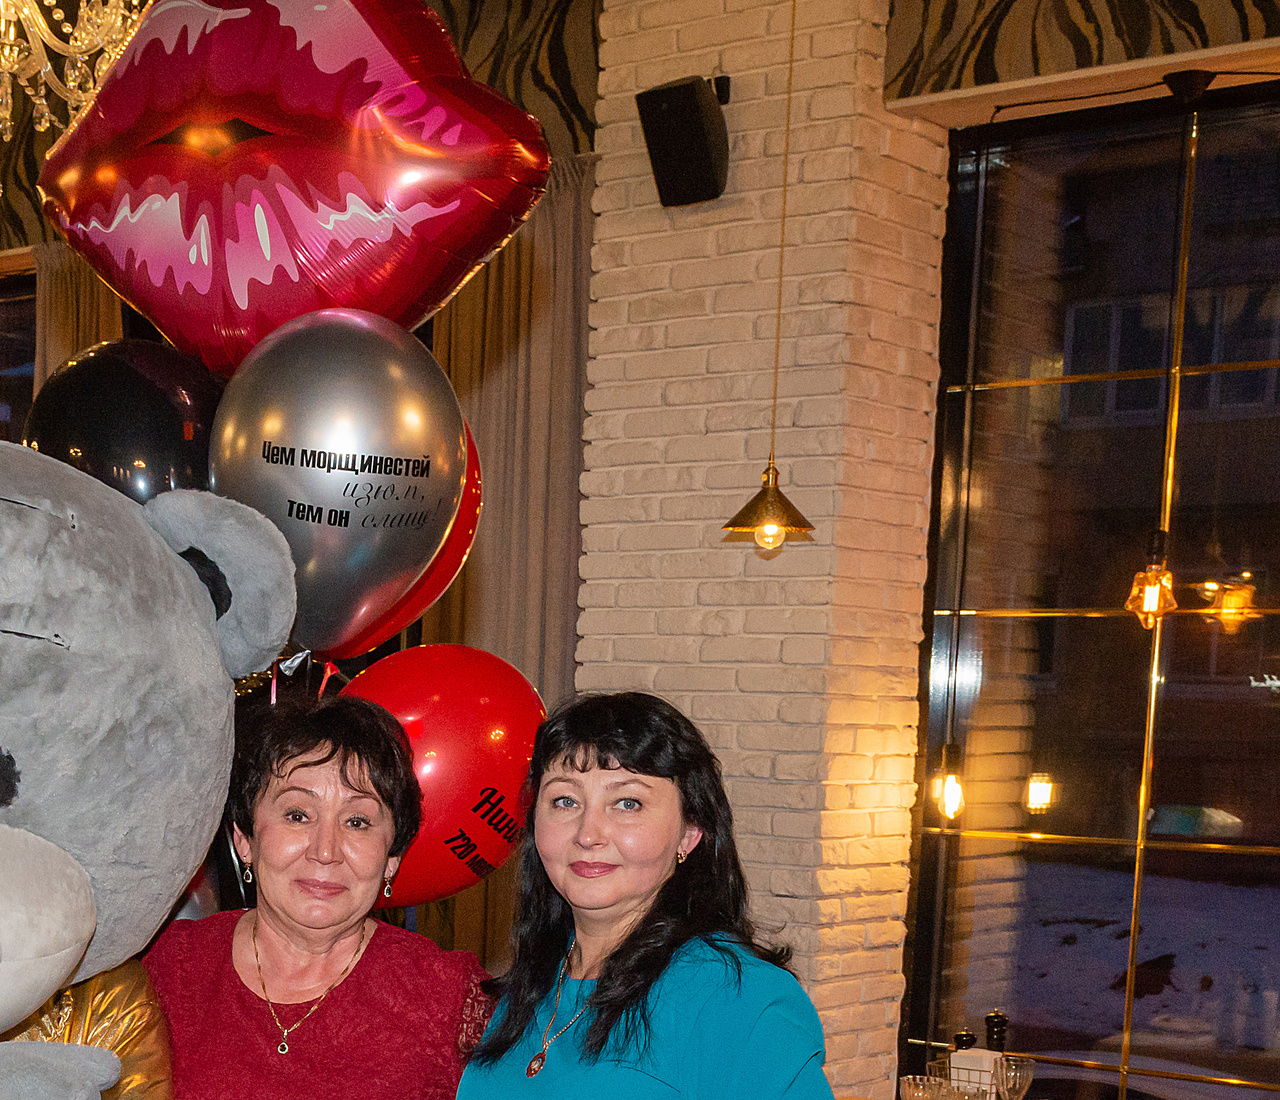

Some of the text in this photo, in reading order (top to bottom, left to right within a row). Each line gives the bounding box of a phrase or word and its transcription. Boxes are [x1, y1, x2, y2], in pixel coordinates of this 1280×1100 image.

[261, 440, 431, 478] Чем морщинестей
[287, 499, 323, 524] тем
[327, 509, 351, 528] он
[443, 828, 478, 860] 720
